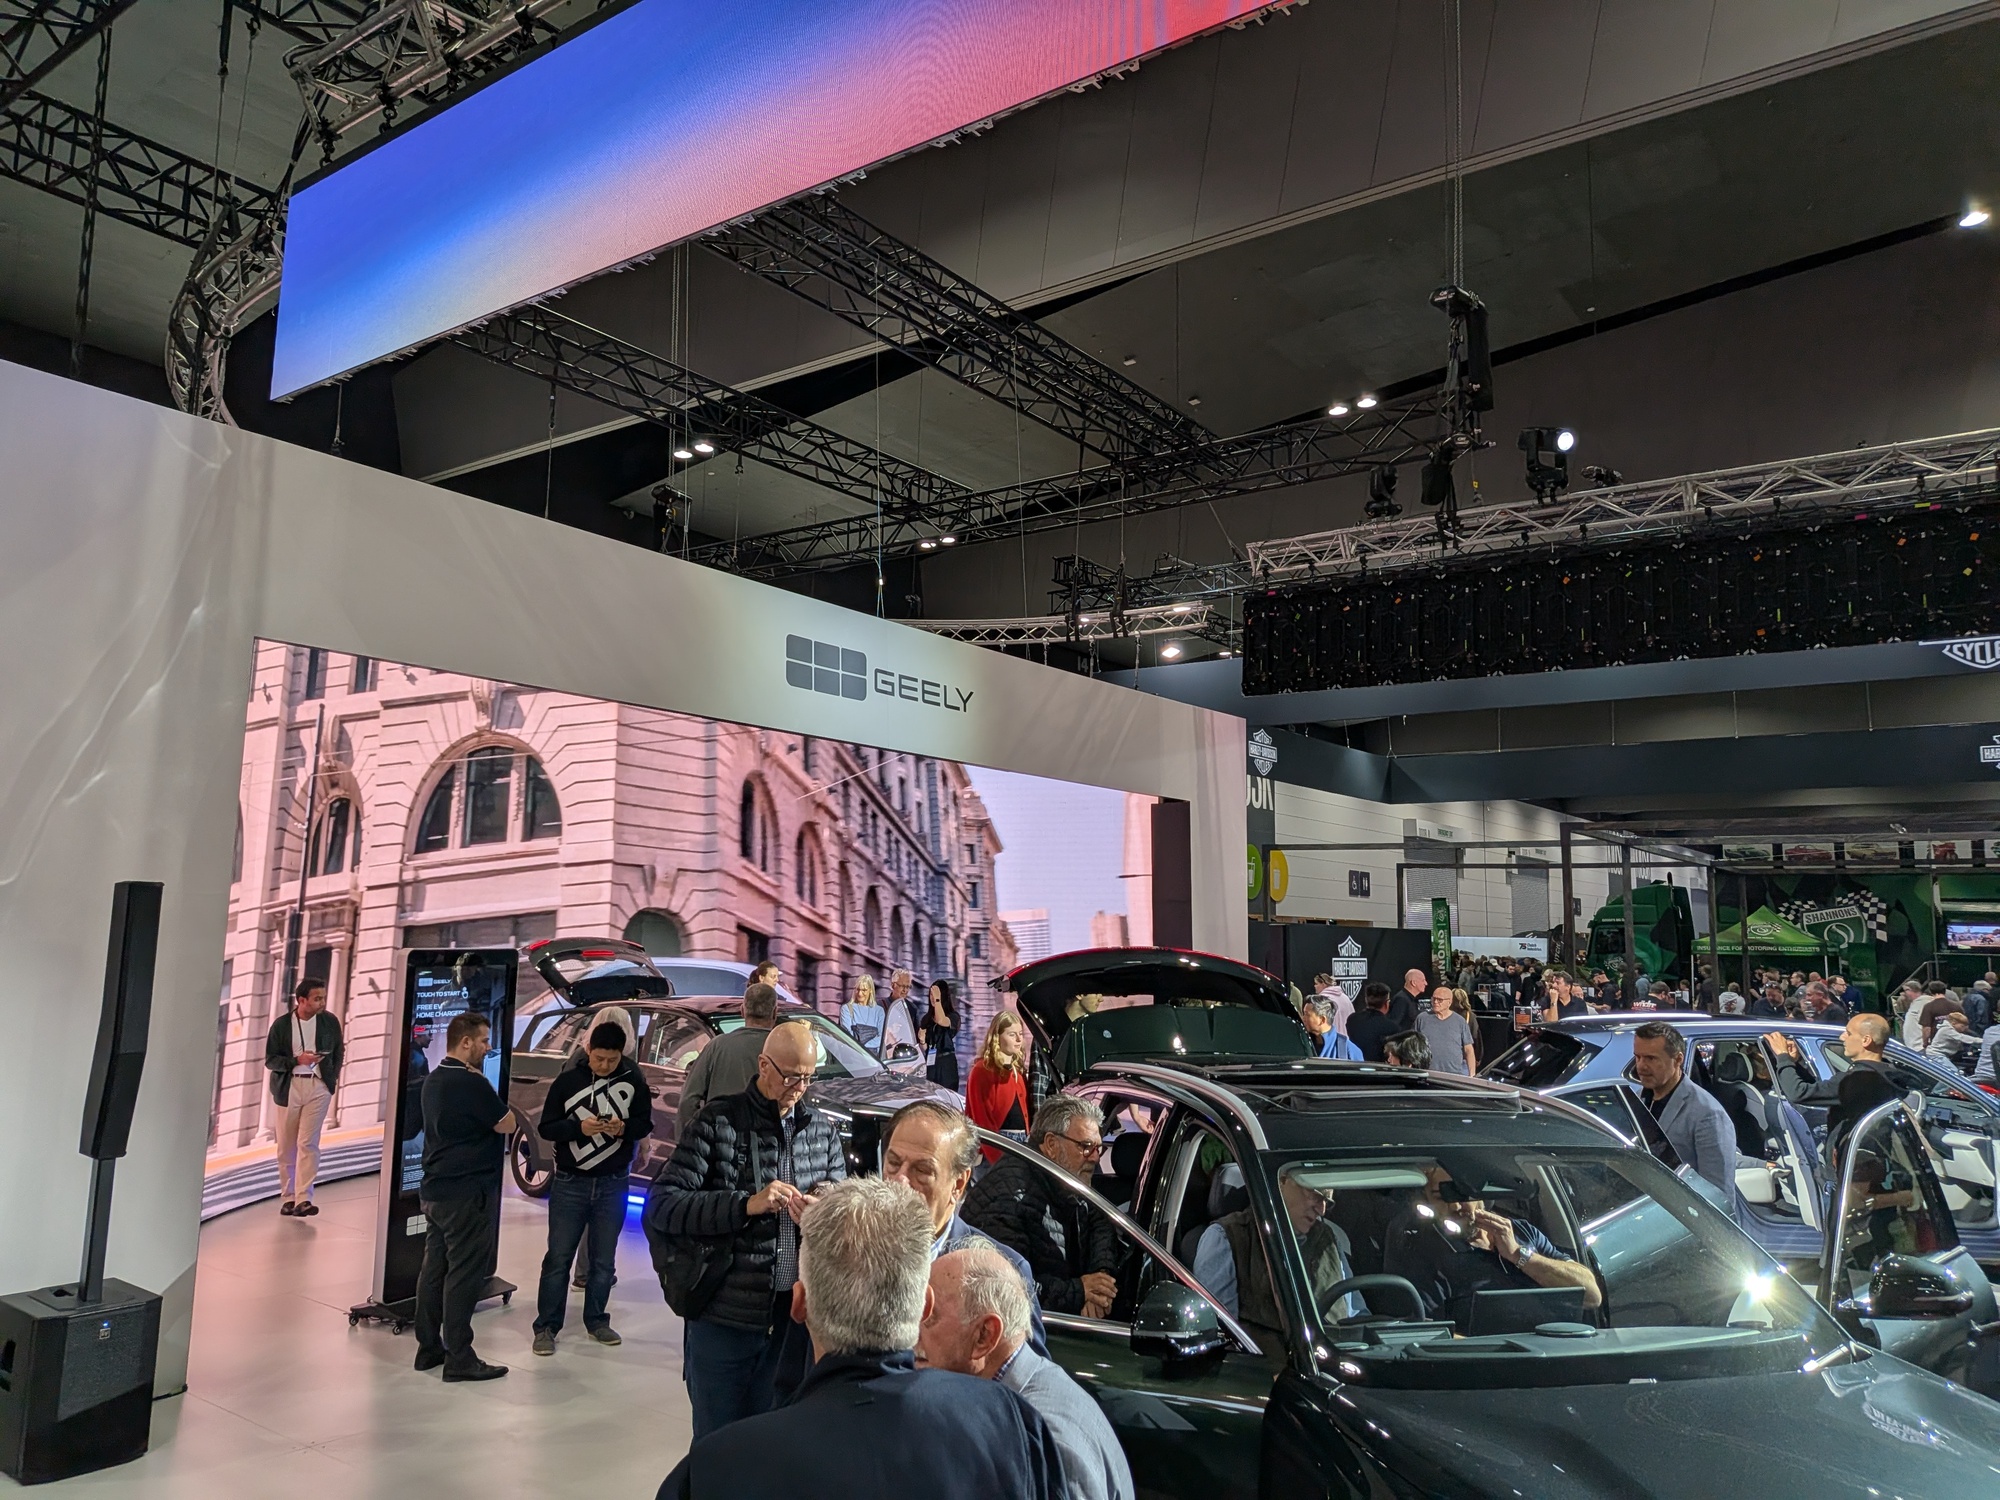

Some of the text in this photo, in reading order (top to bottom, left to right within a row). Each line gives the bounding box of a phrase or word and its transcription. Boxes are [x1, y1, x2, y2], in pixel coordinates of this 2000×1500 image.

[1952, 640, 2000, 664] CYCLE
[874, 667, 974, 713] GEELY
[1805, 906, 1858, 924] SHANNONS
[1437, 929, 1446, 986] NNONS
